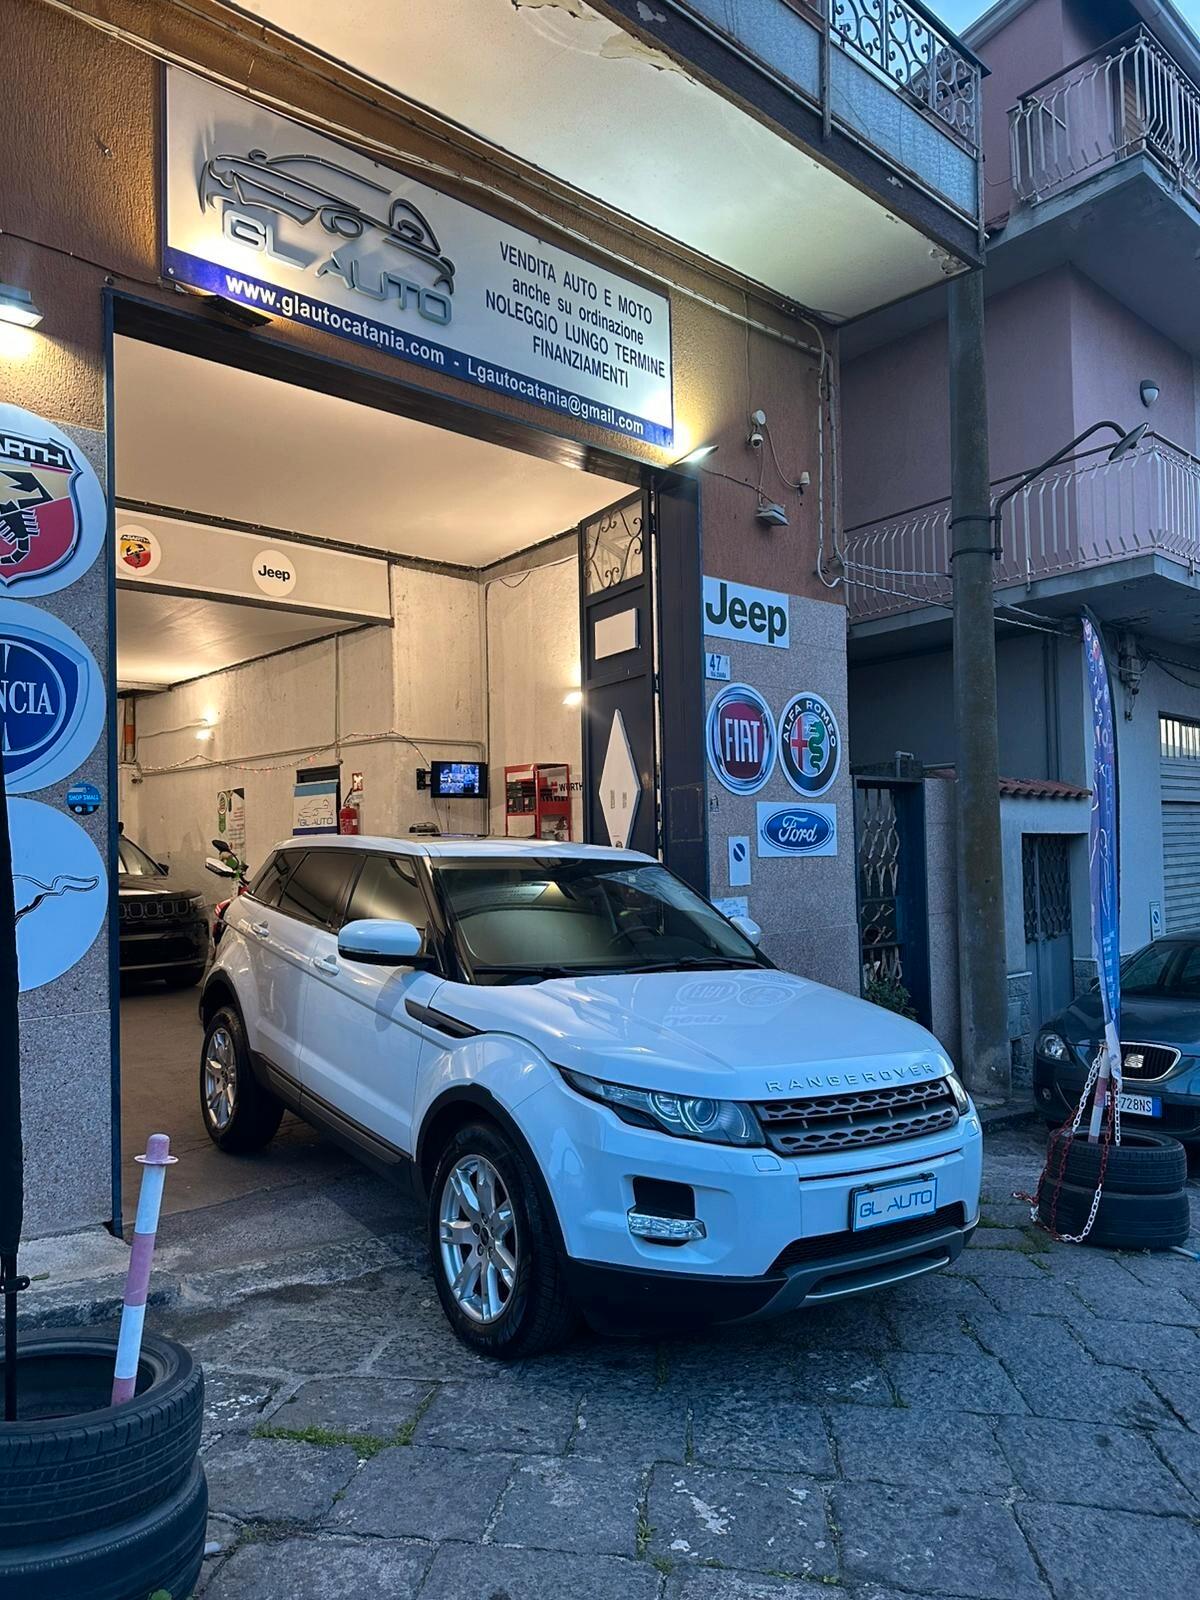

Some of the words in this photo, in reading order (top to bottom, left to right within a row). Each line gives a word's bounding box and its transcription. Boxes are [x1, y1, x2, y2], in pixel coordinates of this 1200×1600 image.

[223, 209, 305, 270] GL
[315, 251, 452, 326] AUTO
[500, 241, 556, 283] VENDITA
[563, 271, 597, 300] AUTO
[604, 289, 612, 307] E
[618, 294, 653, 325] MOTO
[486, 289, 558, 334] NOLEGGIO
[565, 322, 609, 355] LUNGO
[615, 342, 666, 378] TERMINE
[512, 278, 550, 306] anche
[557, 297, 572, 315] su
[579, 306, 644, 345] ordinazione
[225, 274, 445, 365] www.glautocatania.com
[467, 357, 644, 435] Lgautocatania@gmail.com
[533, 335, 629, 388] FINANZIAMENTI
[258, 565, 290, 582] Jeep
[705, 583, 787, 644] Jeep
[710, 654, 721, 671] 47
[725, 718, 760, 763] FIAT
[783, 704, 801, 743] ALFA
[806, 700, 836, 747] ROMEO
[312, 817, 334, 825] AUTO
[779, 815, 818, 842] Ford
[860, 1201, 882, 1217] GL
[887, 1190, 932, 1212] AUTO
